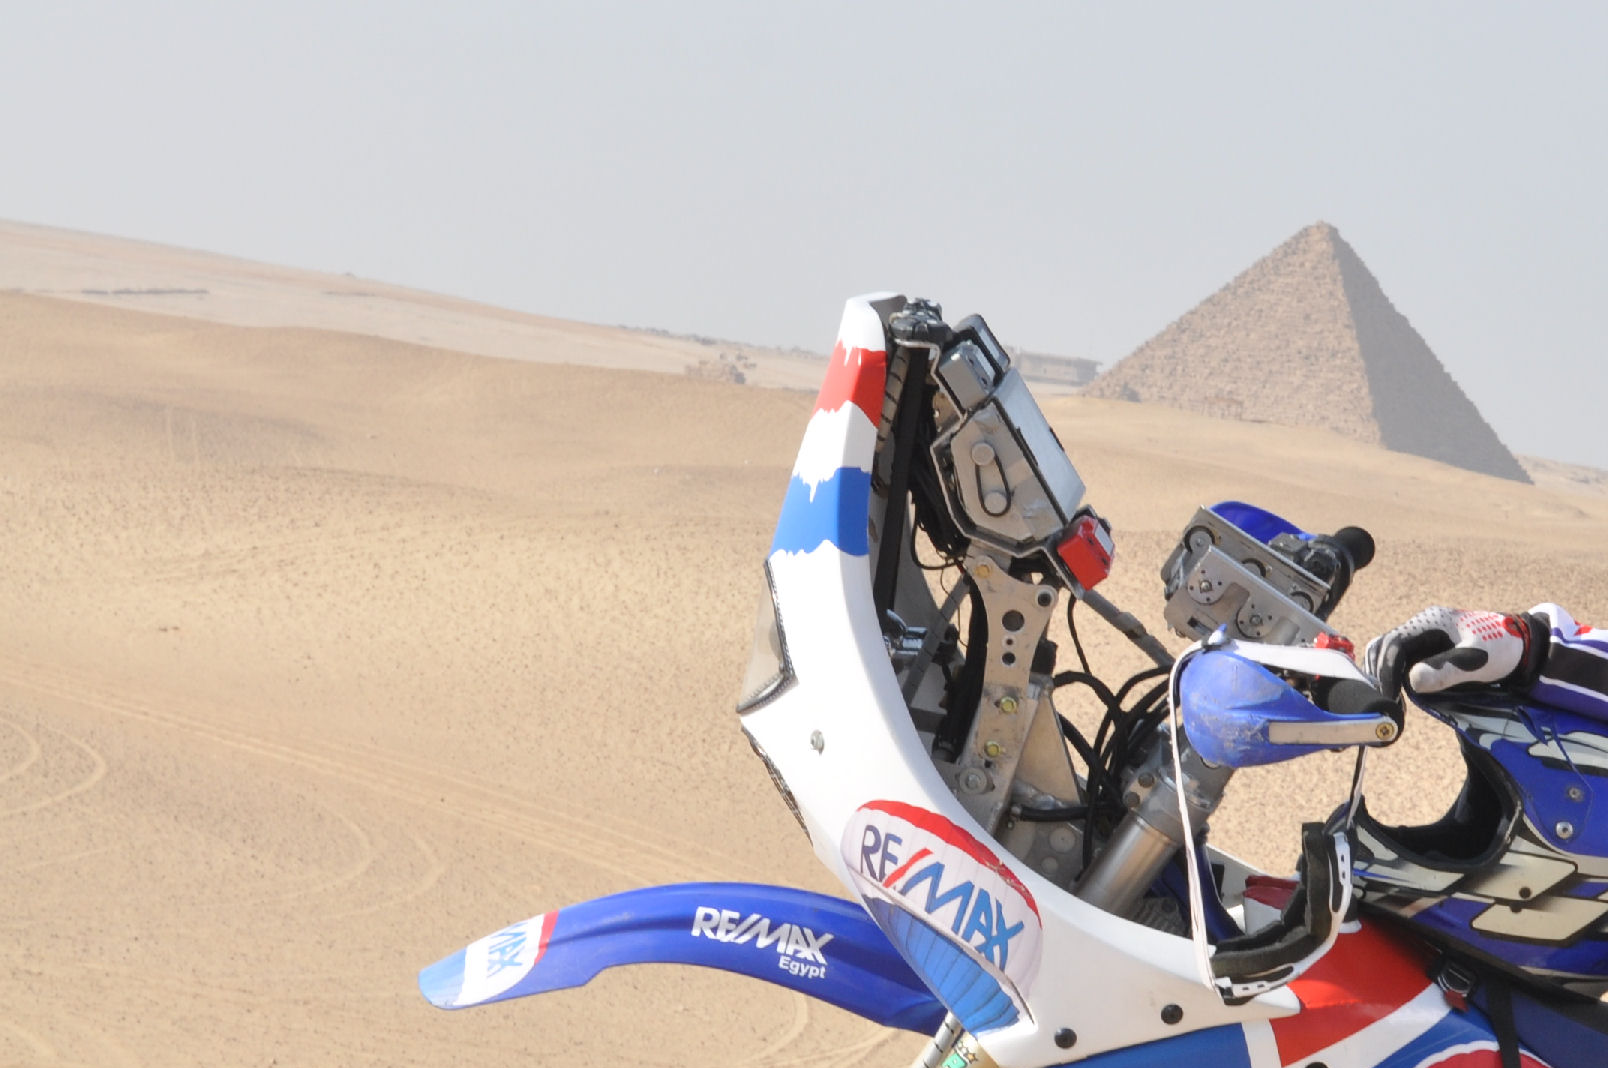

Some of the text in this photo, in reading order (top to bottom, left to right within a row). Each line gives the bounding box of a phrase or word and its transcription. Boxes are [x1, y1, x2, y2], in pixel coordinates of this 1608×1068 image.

[857, 823, 1025, 973] RE/MAX
[691, 905, 834, 966] RE/MAX
[778, 955, 826, 979] Egypt
